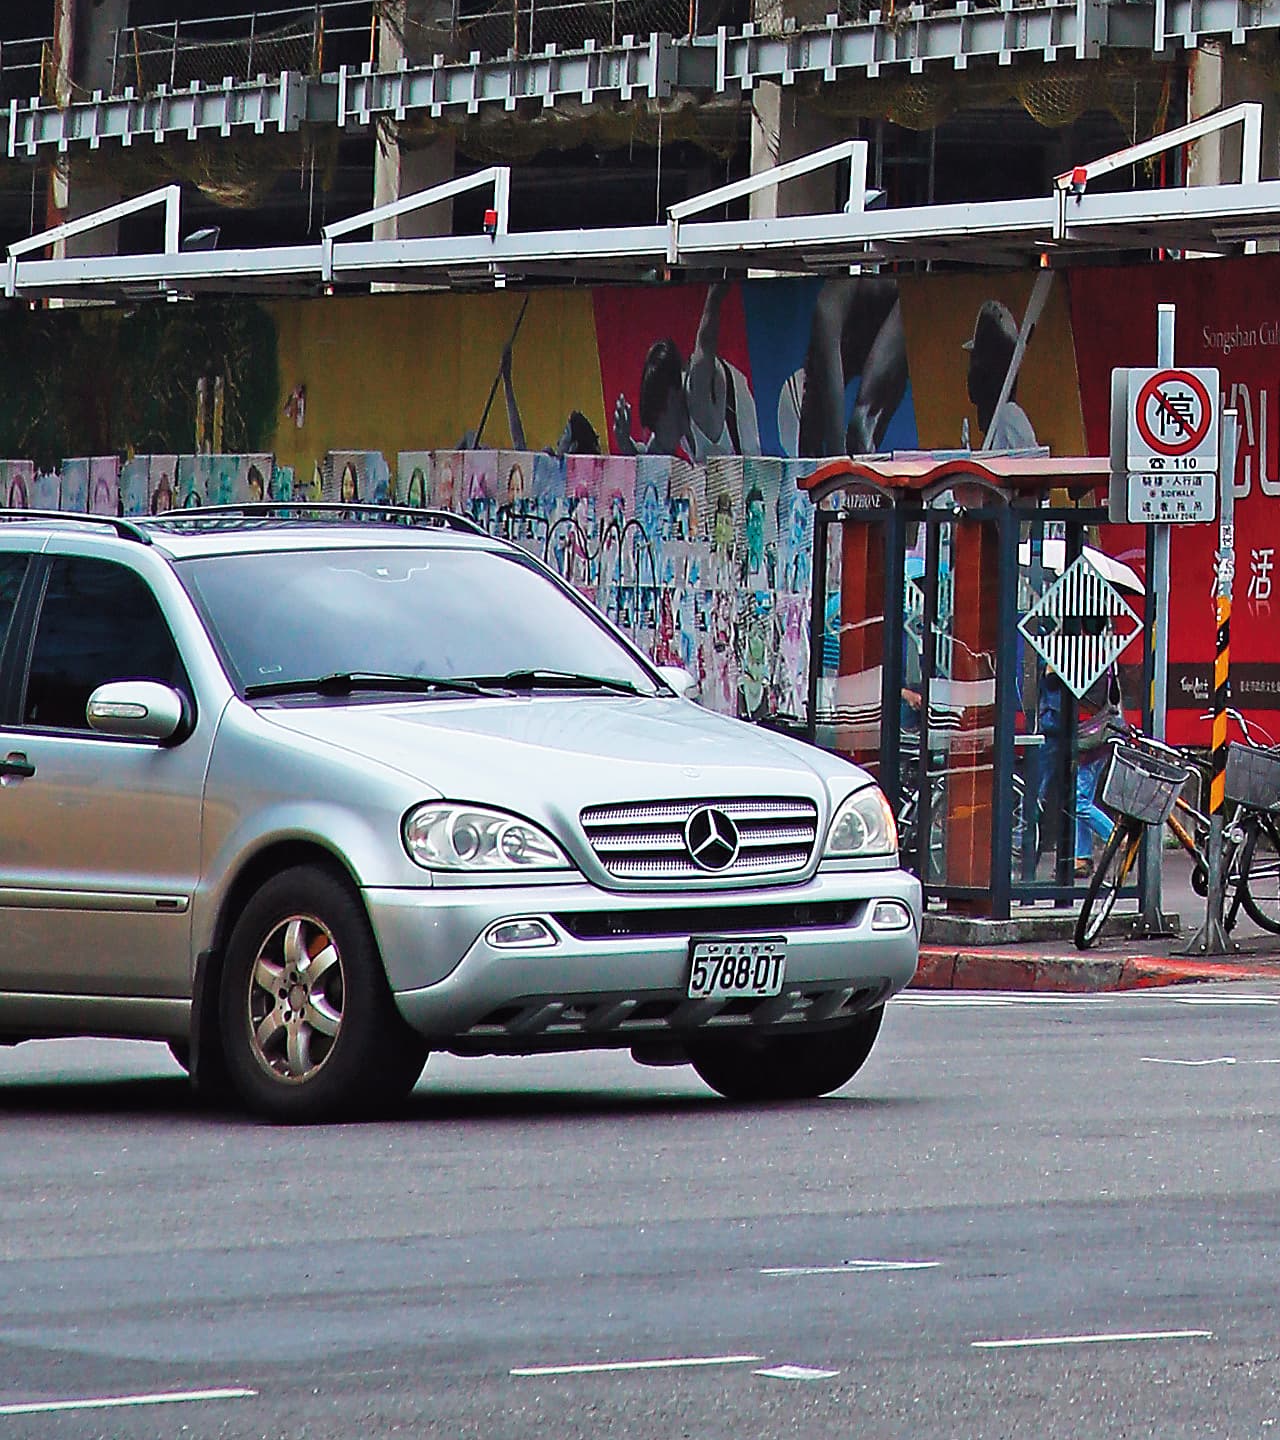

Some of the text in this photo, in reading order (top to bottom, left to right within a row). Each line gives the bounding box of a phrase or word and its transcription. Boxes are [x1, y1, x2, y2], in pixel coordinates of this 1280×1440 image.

[1202, 324, 1257, 355] Songshan
[1155, 391, 1195, 437] 停
[1173, 457, 1198, 470] 110
